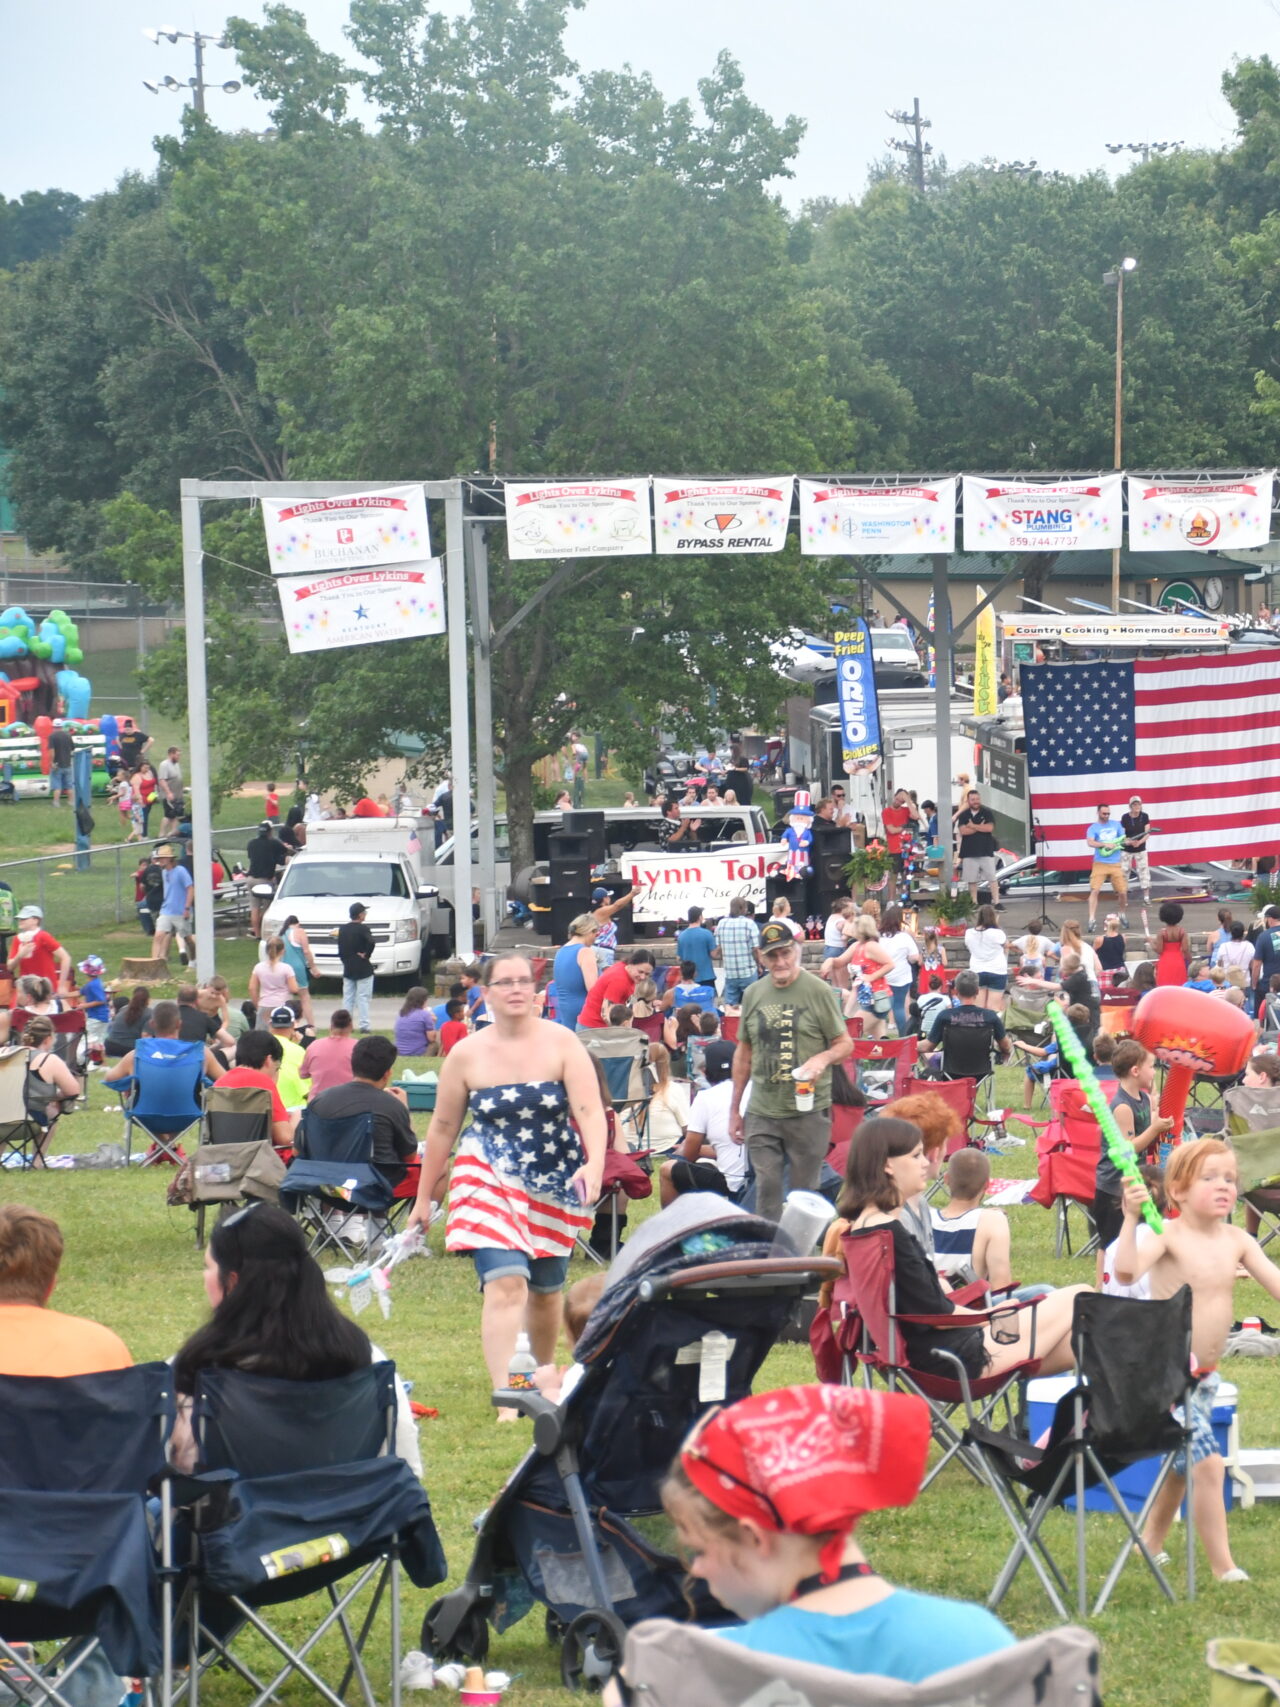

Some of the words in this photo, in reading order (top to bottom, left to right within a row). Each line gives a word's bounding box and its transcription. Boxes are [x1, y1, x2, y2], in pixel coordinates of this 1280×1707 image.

[529, 488, 561, 500] Lights
[562, 486, 587, 496] Over
[588, 487, 621, 498] Lykins
[678, 488, 708, 499] Lights
[709, 486, 734, 495] Over
[736, 486, 769, 497] Lykins
[827, 487, 858, 499] Lights
[292, 500, 325, 517] Lights
[326, 497, 353, 508] Over
[355, 496, 392, 509] Lykins
[1011, 508, 1072, 524] STANG
[1026, 523, 1066, 531] PLUMBING
[677, 537, 724, 549] BYPASS
[727, 537, 773, 548] RENTAL
[314, 543, 381, 559] BUCHANAN
[308, 578, 342, 594] Lights
[343, 573, 370, 585] Over
[373, 570, 409, 582] Lykins
[834, 631, 865, 644] Deep
[1016, 626, 1062, 636] Country
[1065, 626, 1109, 636] Cooking
[1120, 626, 1181, 635] Homemade
[1184, 626, 1218, 636] Candy
[835, 642, 865, 656] Fried
[841, 659, 867, 743] OREO
[631, 865, 702, 892] Lynn
[720, 855, 783, 881] Tole
[780, 1009, 794, 1081] VETERAN
